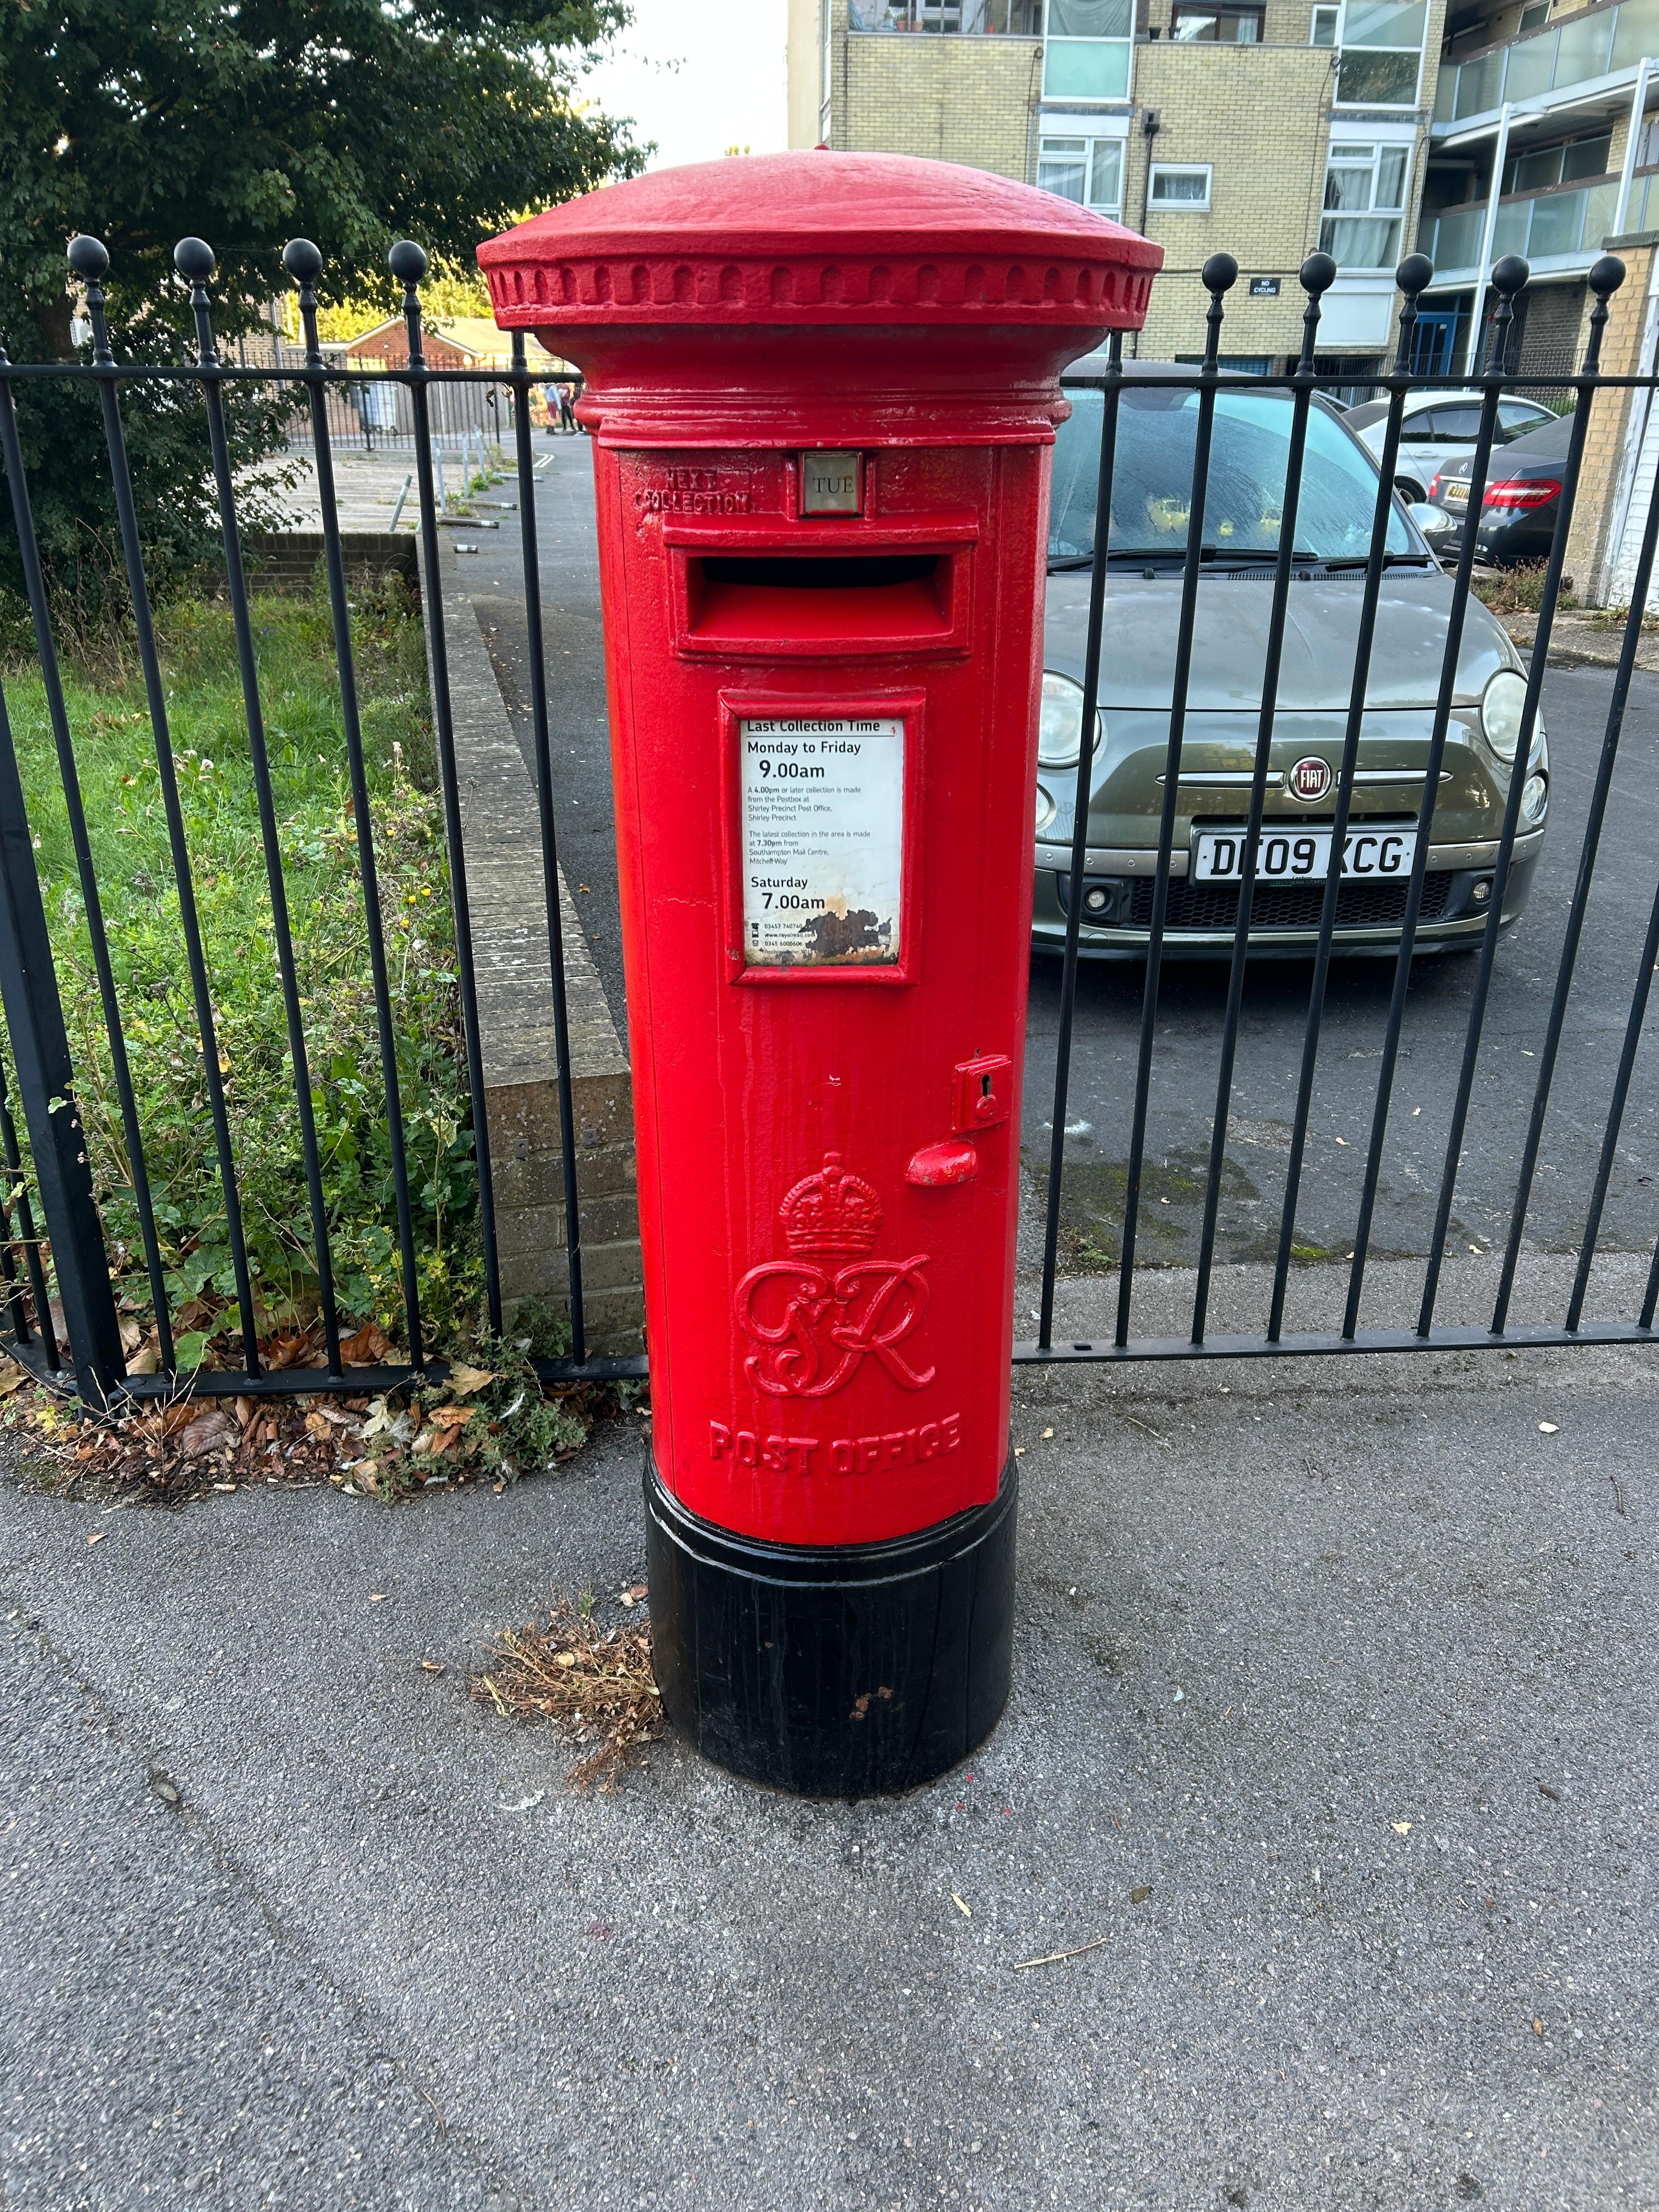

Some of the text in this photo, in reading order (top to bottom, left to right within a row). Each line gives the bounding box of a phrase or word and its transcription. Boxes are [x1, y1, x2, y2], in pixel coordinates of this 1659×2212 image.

[665, 469, 714, 489] NEXT
[813, 477, 853, 493] TUE
[635, 490, 751, 514] COLLECTION
[747, 720, 881, 731] Last Collection Time
[748, 741, 861, 755] Monday to Friday
[759, 760, 825, 778] 9.00am
[1301, 770, 1323, 788] FIAT
[748, 805, 770, 813] Shirley
[774, 857, 788, 866] Way
[751, 877, 808, 889] Saturday
[761, 893, 825, 909] 7.00am
[710, 1413, 960, 1475] POST OFFICE
